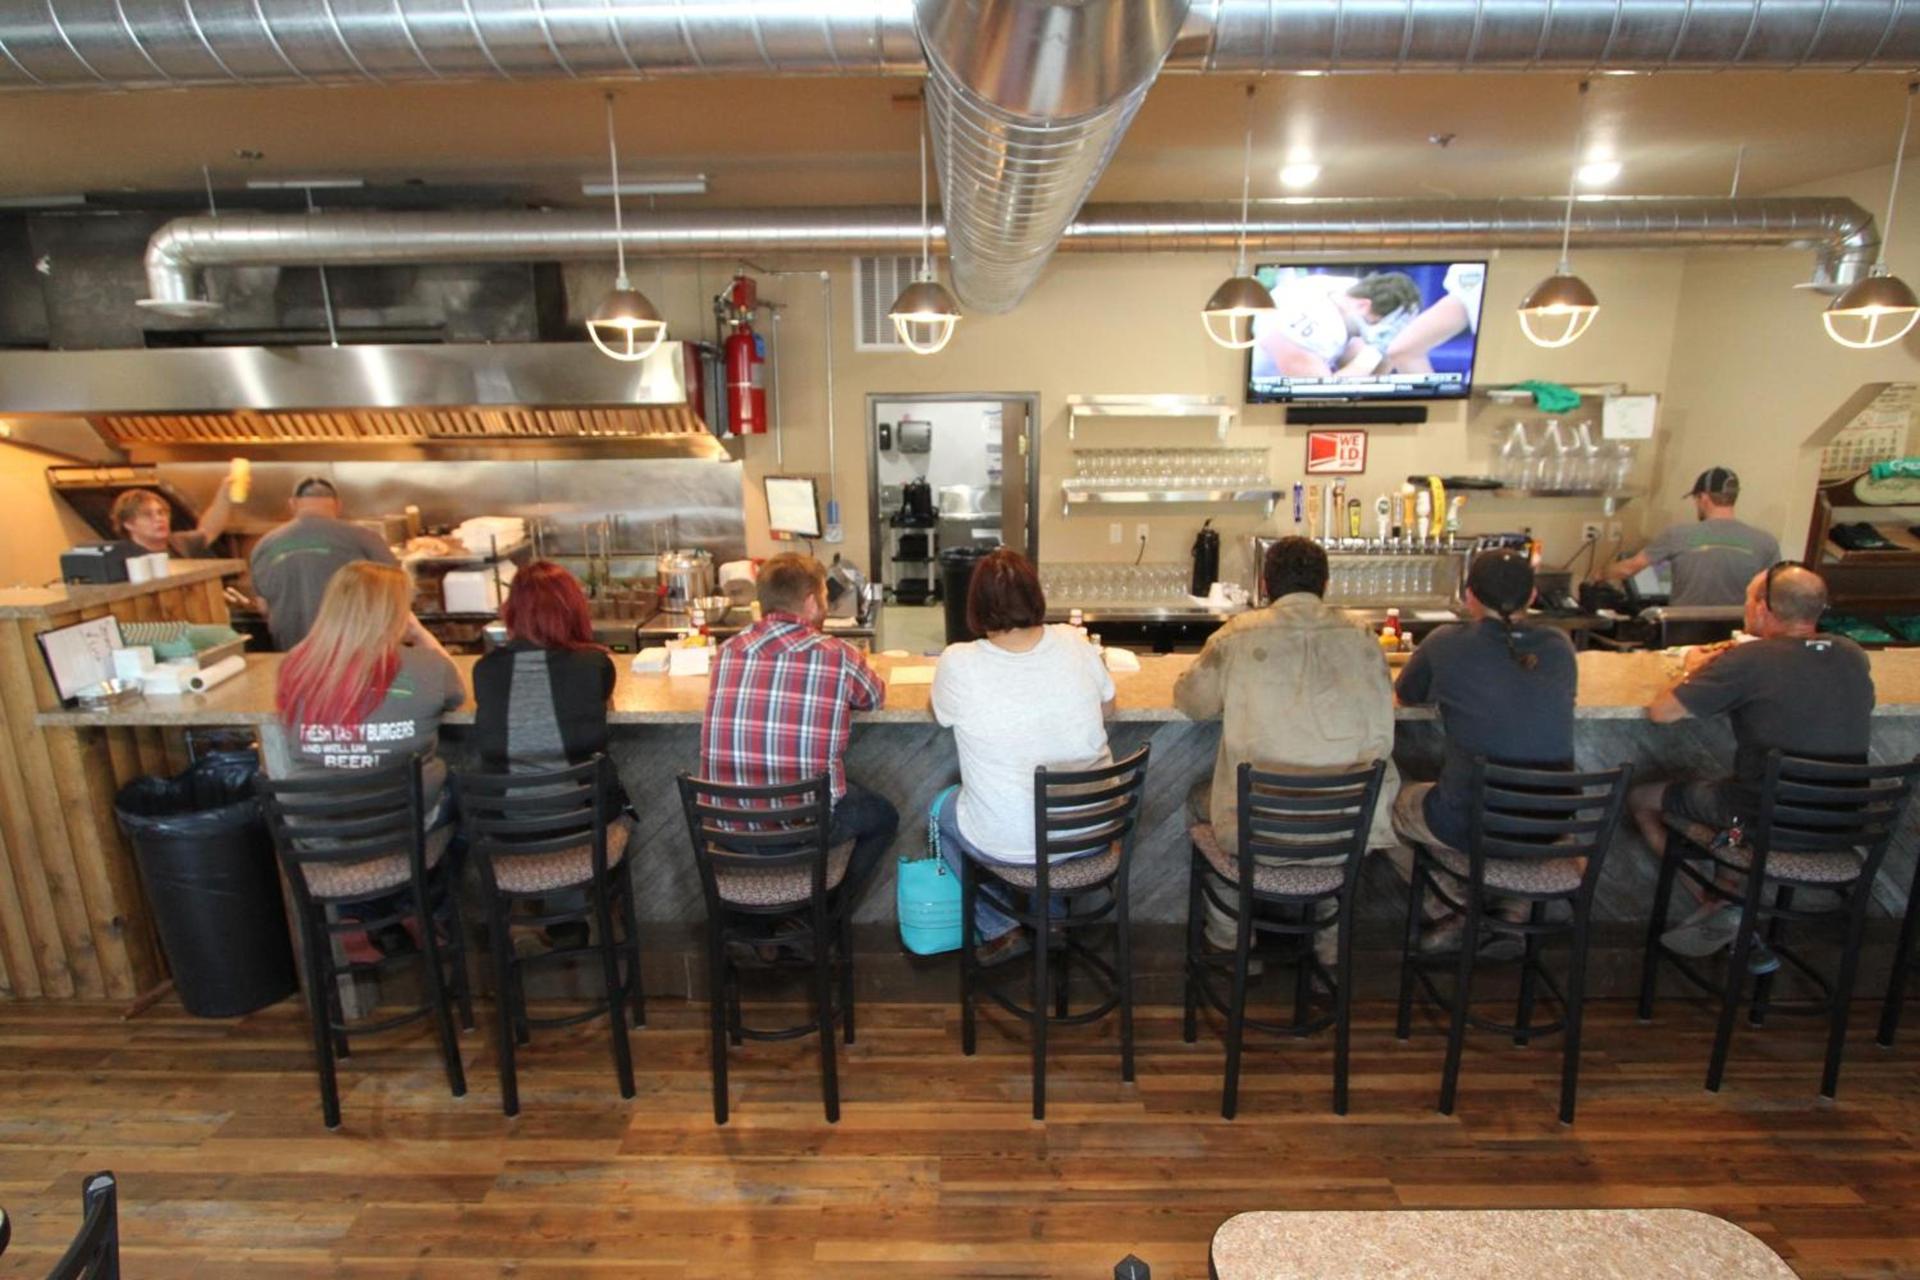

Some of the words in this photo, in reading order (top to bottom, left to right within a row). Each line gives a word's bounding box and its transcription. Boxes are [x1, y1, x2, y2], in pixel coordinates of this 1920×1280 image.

[1340, 434, 1360, 446] WE
[367, 719, 415, 741] BURGERS
[324, 755, 379, 768] BEER!
